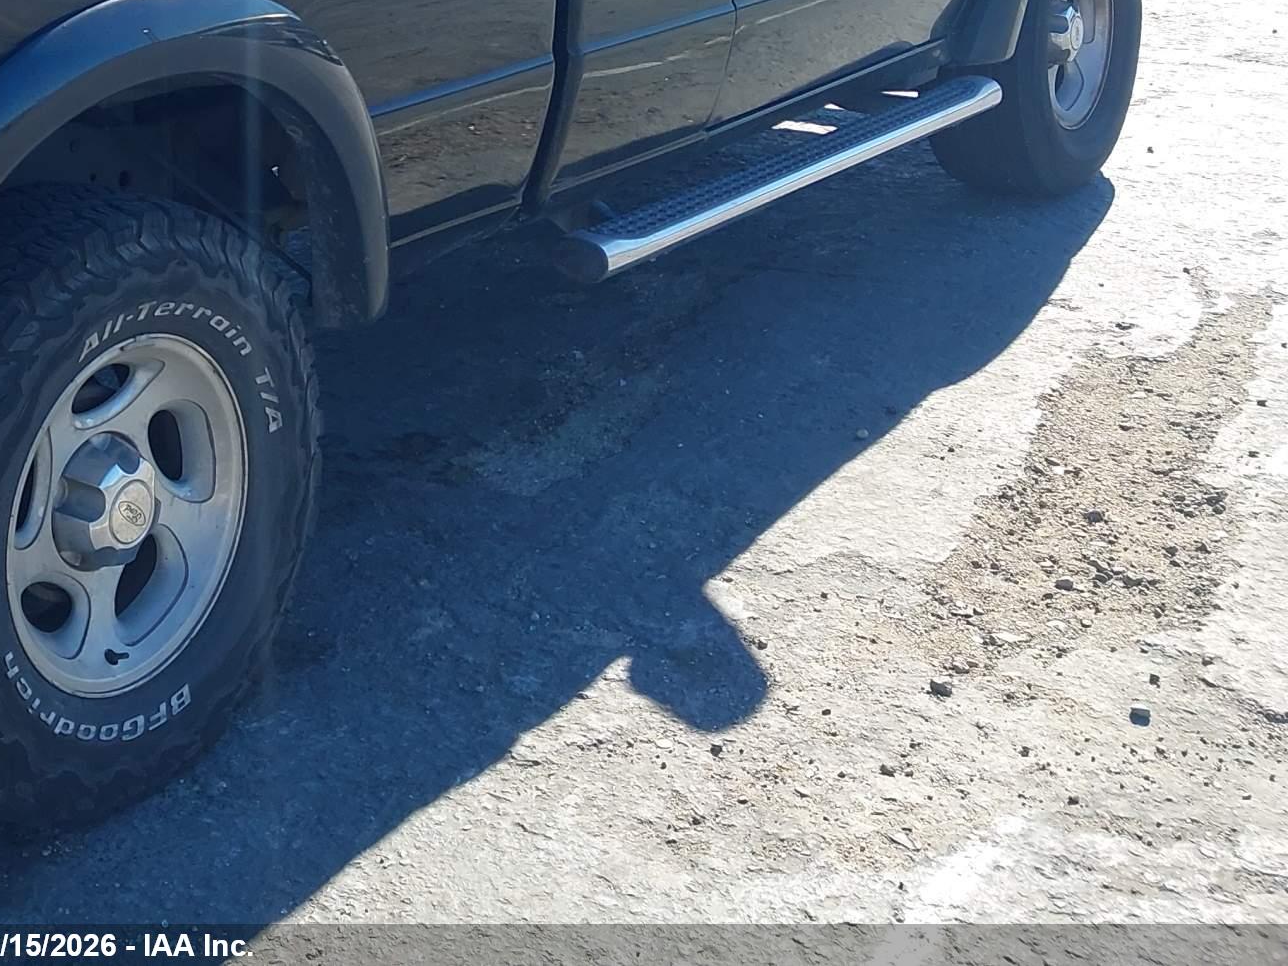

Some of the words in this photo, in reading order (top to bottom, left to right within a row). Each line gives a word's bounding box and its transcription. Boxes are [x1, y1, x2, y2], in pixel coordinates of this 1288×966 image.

[78, 300, 253, 363] All-Terrain
[255, 366, 283, 433] T/A
[4, 651, 192, 741] BFGoodrich
